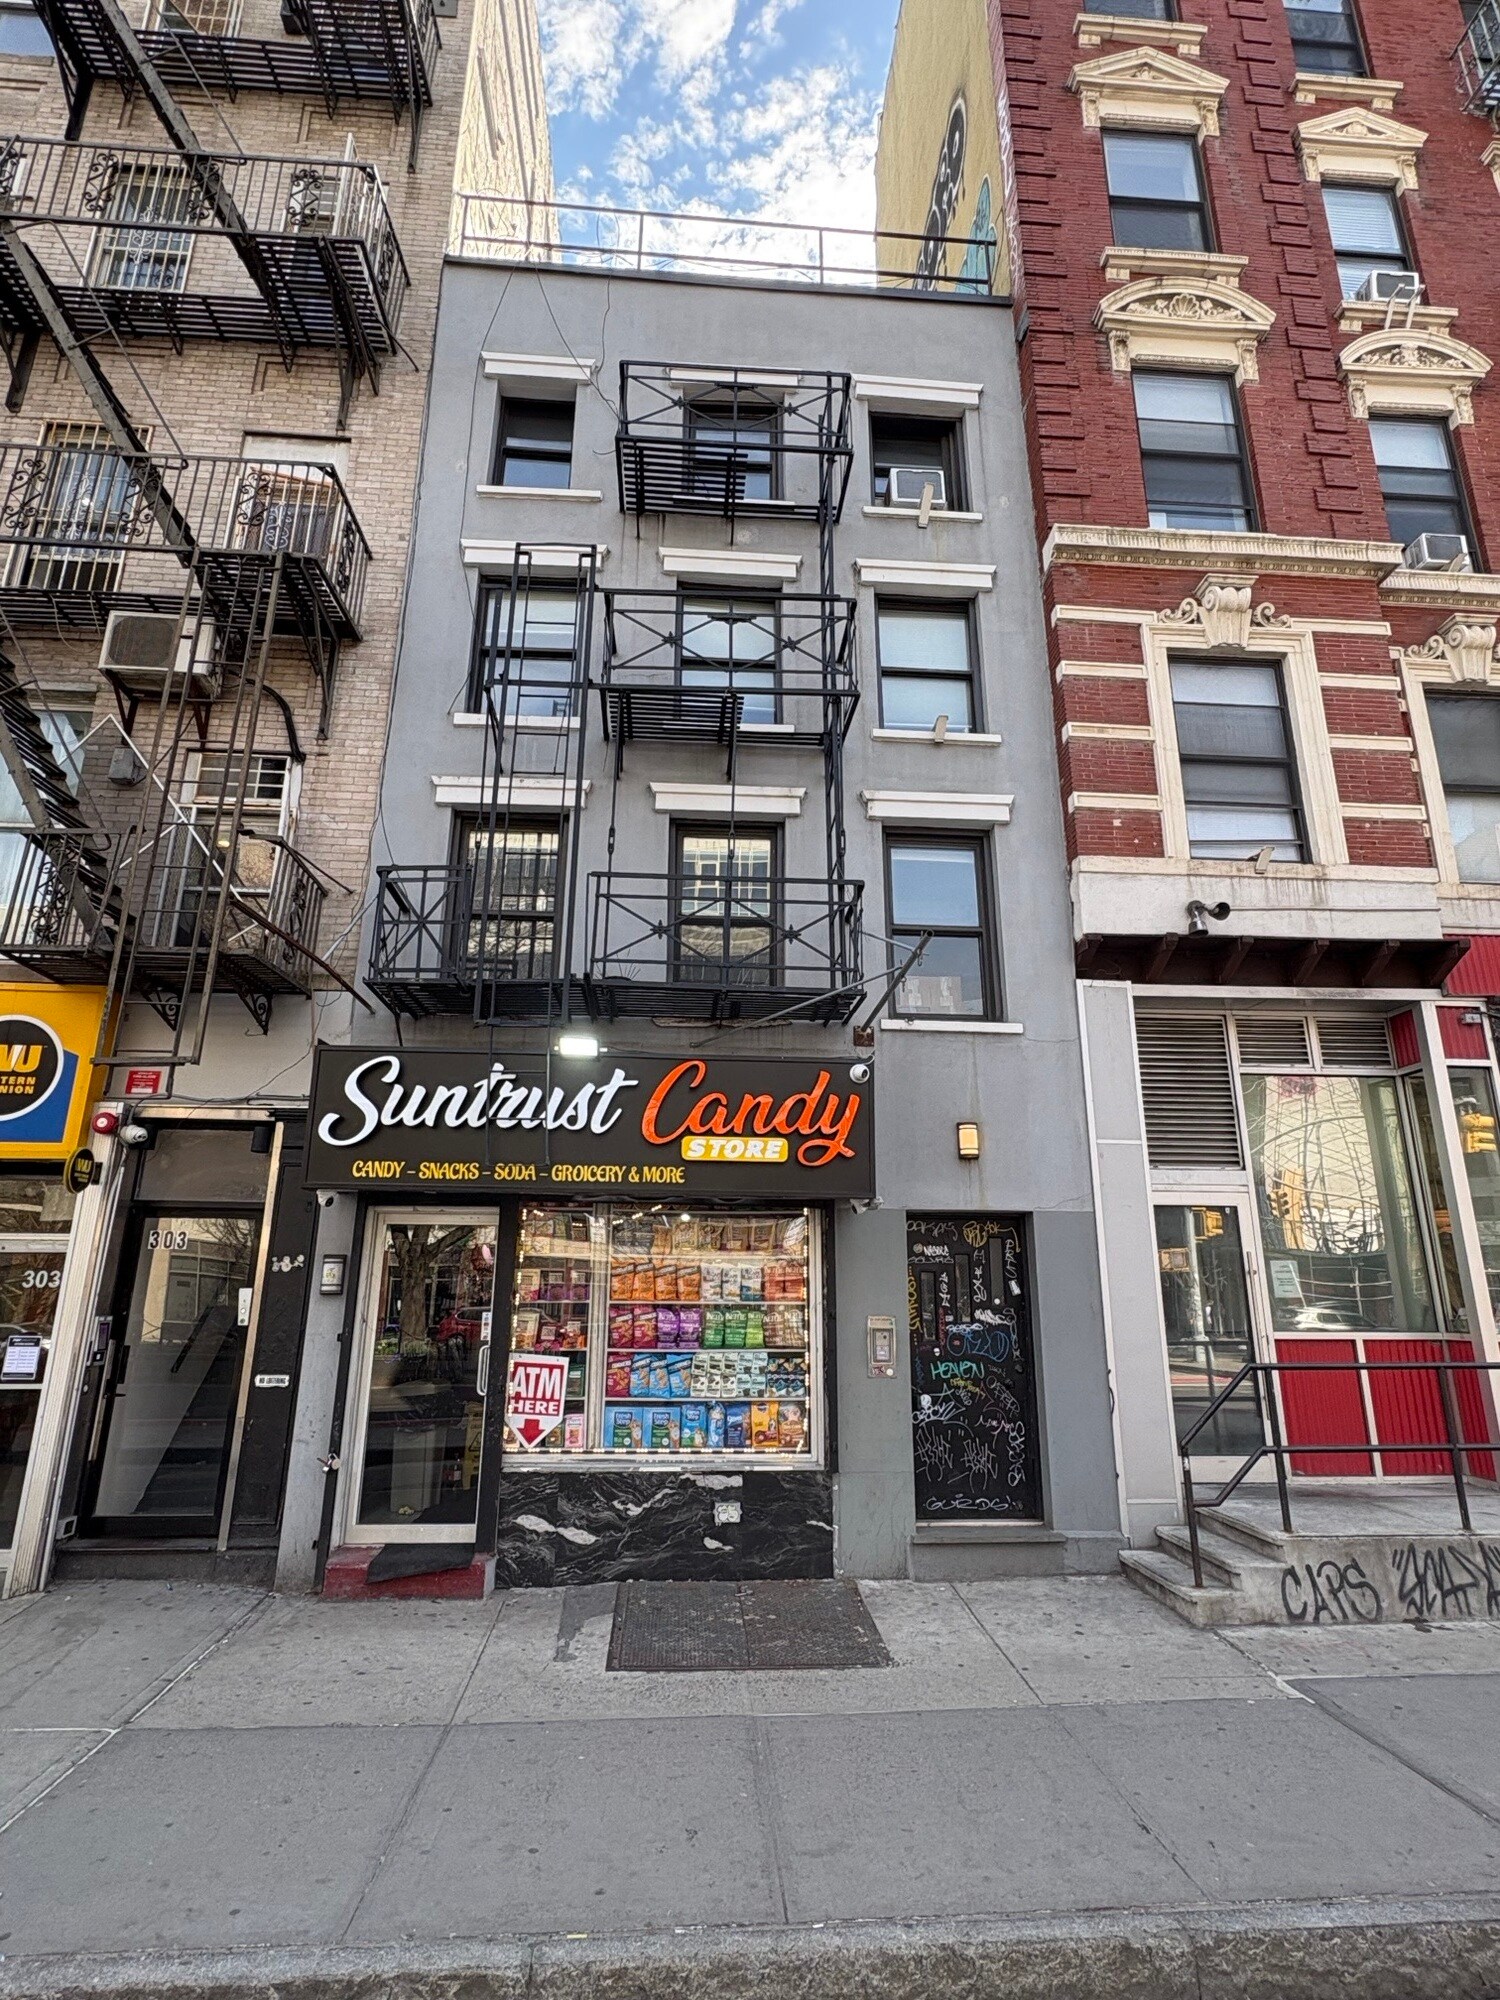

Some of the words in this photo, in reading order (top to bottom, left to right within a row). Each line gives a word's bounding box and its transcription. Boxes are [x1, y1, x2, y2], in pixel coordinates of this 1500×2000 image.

[0, 1076, 36, 1085] TERN
[0, 1085, 35, 1094] NION
[317, 1055, 639, 1147] Suntrust
[641, 1060, 862, 1167] Candy
[687, 1138, 784, 1159] STORE
[352, 1160, 405, 1179] CANDY
[418, 1162, 479, 1180] SNACKS
[494, 1163, 537, 1181] SODA
[628, 1166, 639, 1183] &
[642, 1166, 686, 1184] MORE
[150, 1231, 187, 1249] 303
[22, 1270, 61, 1289] 303
[511, 1366, 562, 1400] ATM
[510, 1400, 559, 1415] HERE
